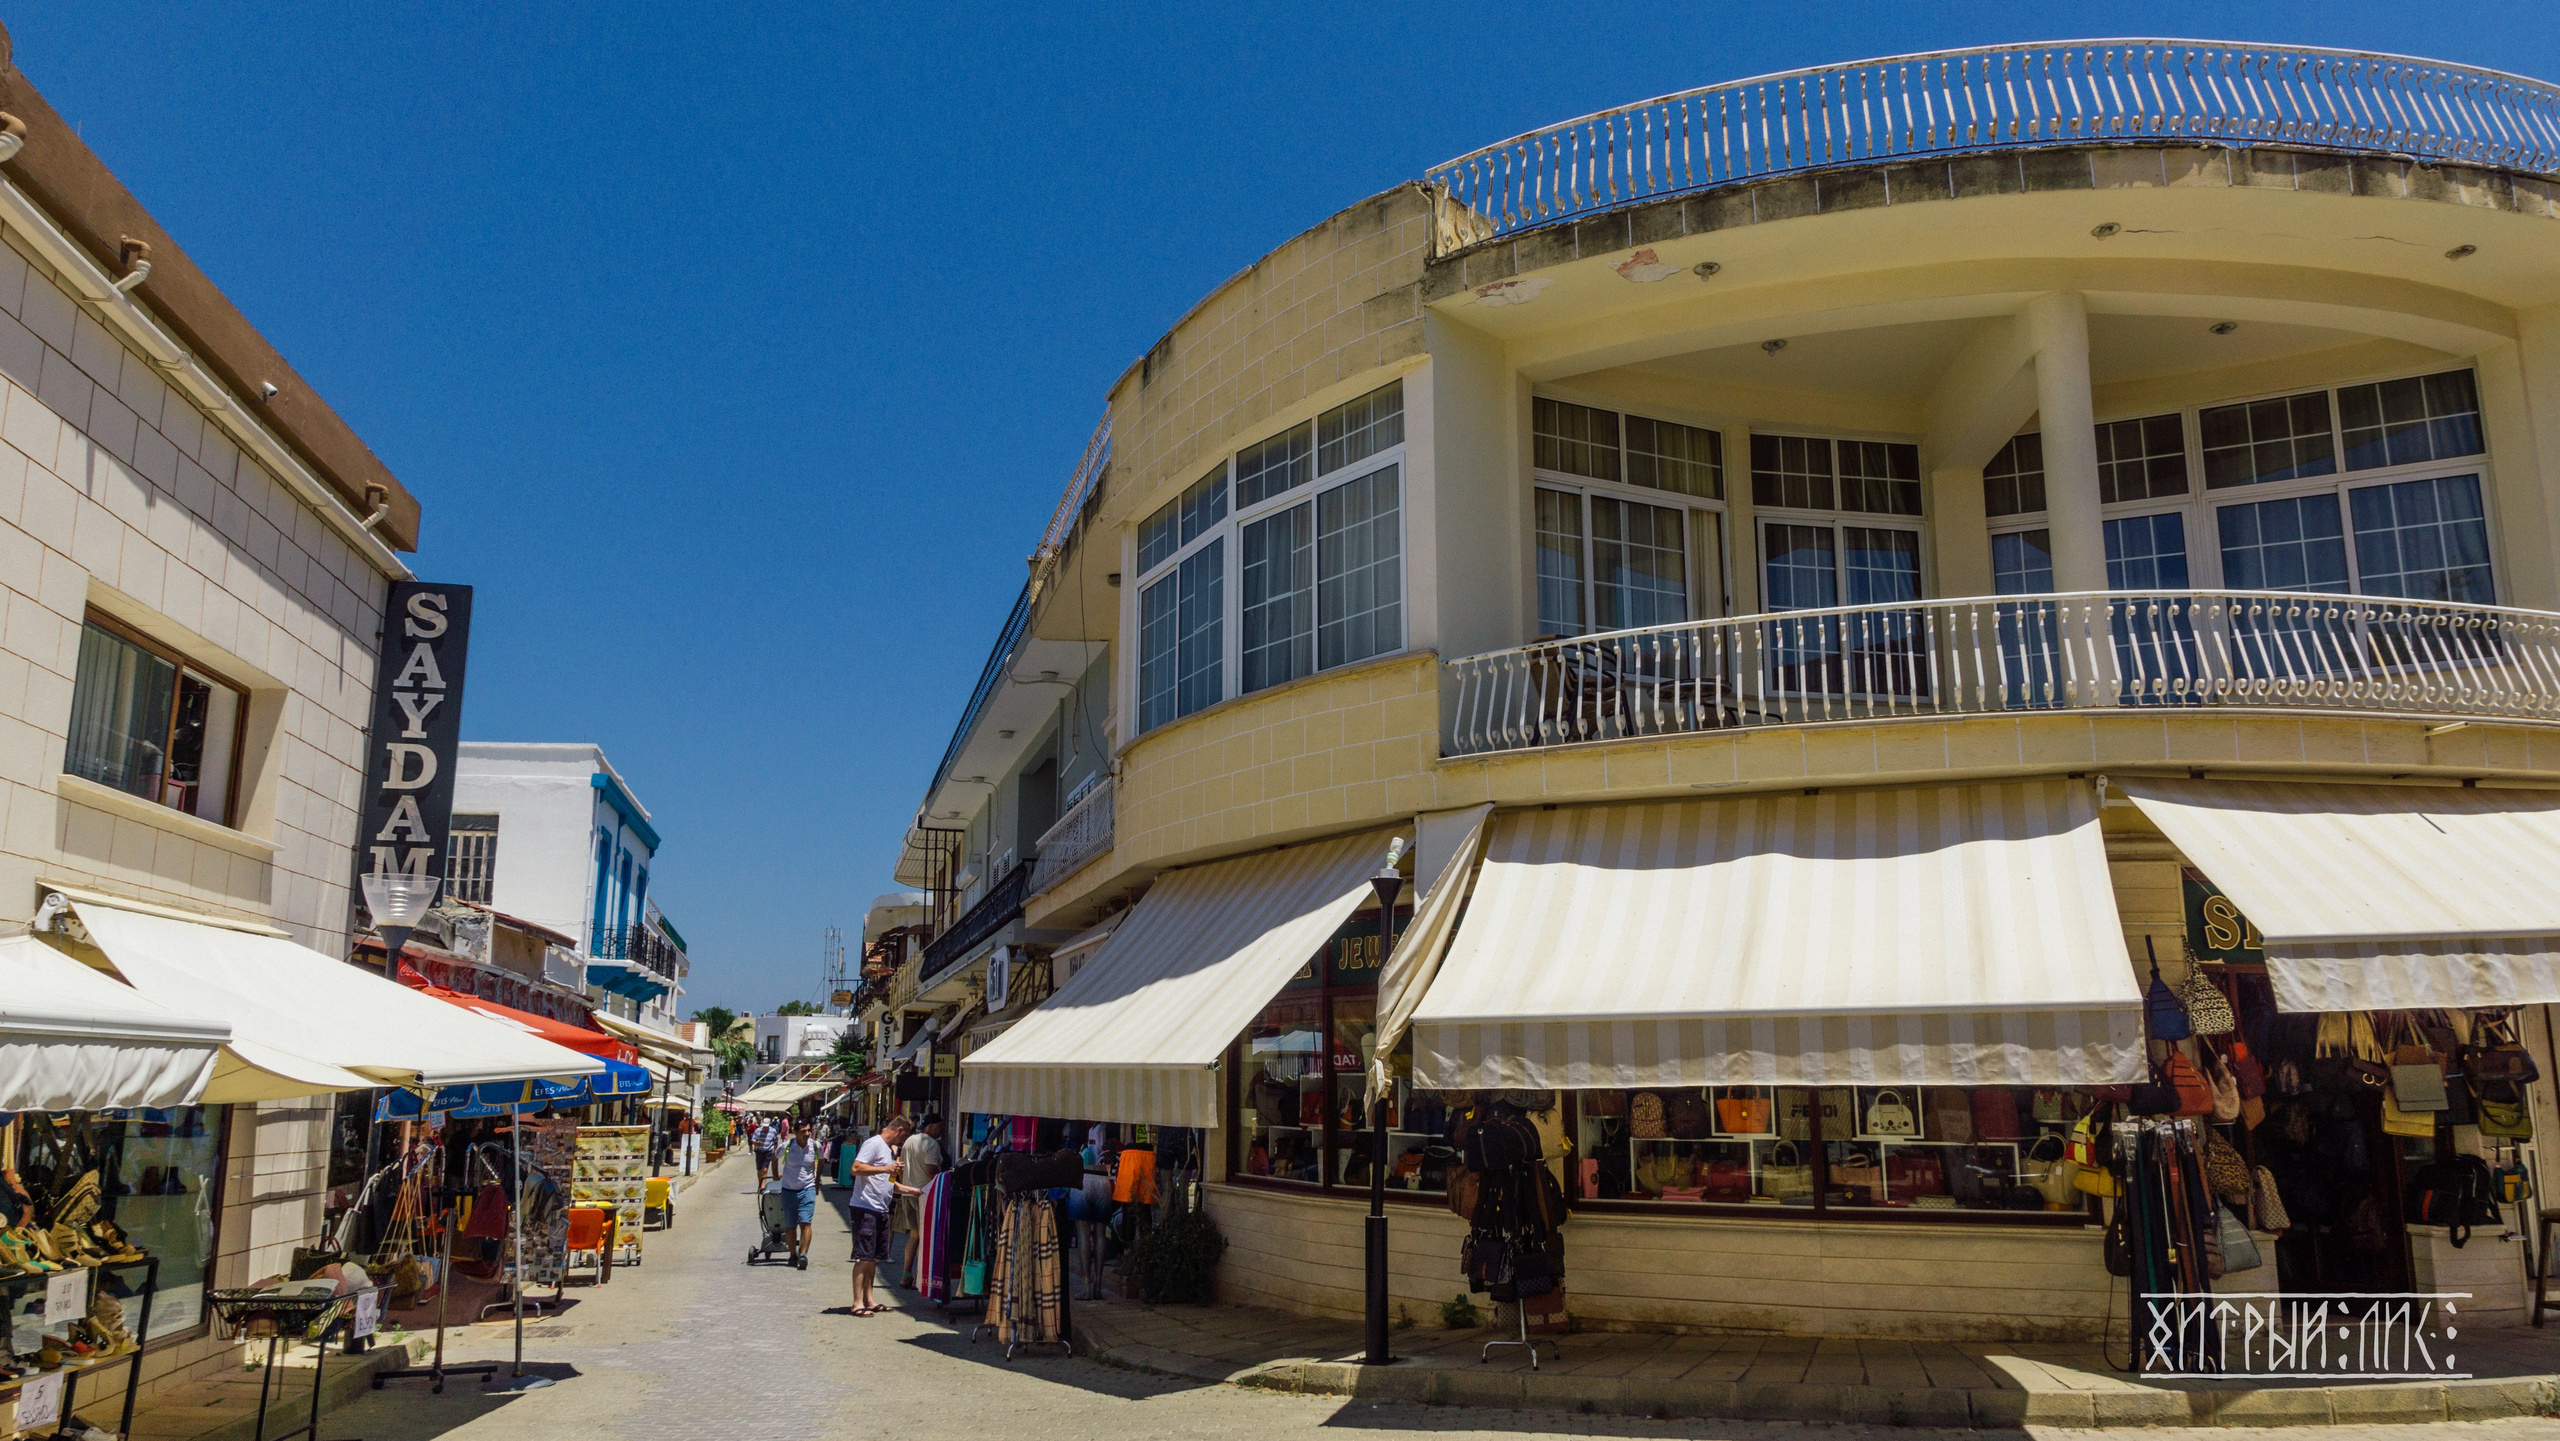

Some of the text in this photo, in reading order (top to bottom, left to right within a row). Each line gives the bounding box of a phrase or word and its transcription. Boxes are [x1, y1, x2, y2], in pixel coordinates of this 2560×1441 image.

[369, 591, 449, 893] SAYDAM
[882, 1026, 891, 1058] STY
[535, 1086, 555, 1097] EFES
[433, 1096, 448, 1107] EFES
[1791, 1104, 1838, 1118] FEDI
[35, 1385, 45, 1400] 5
